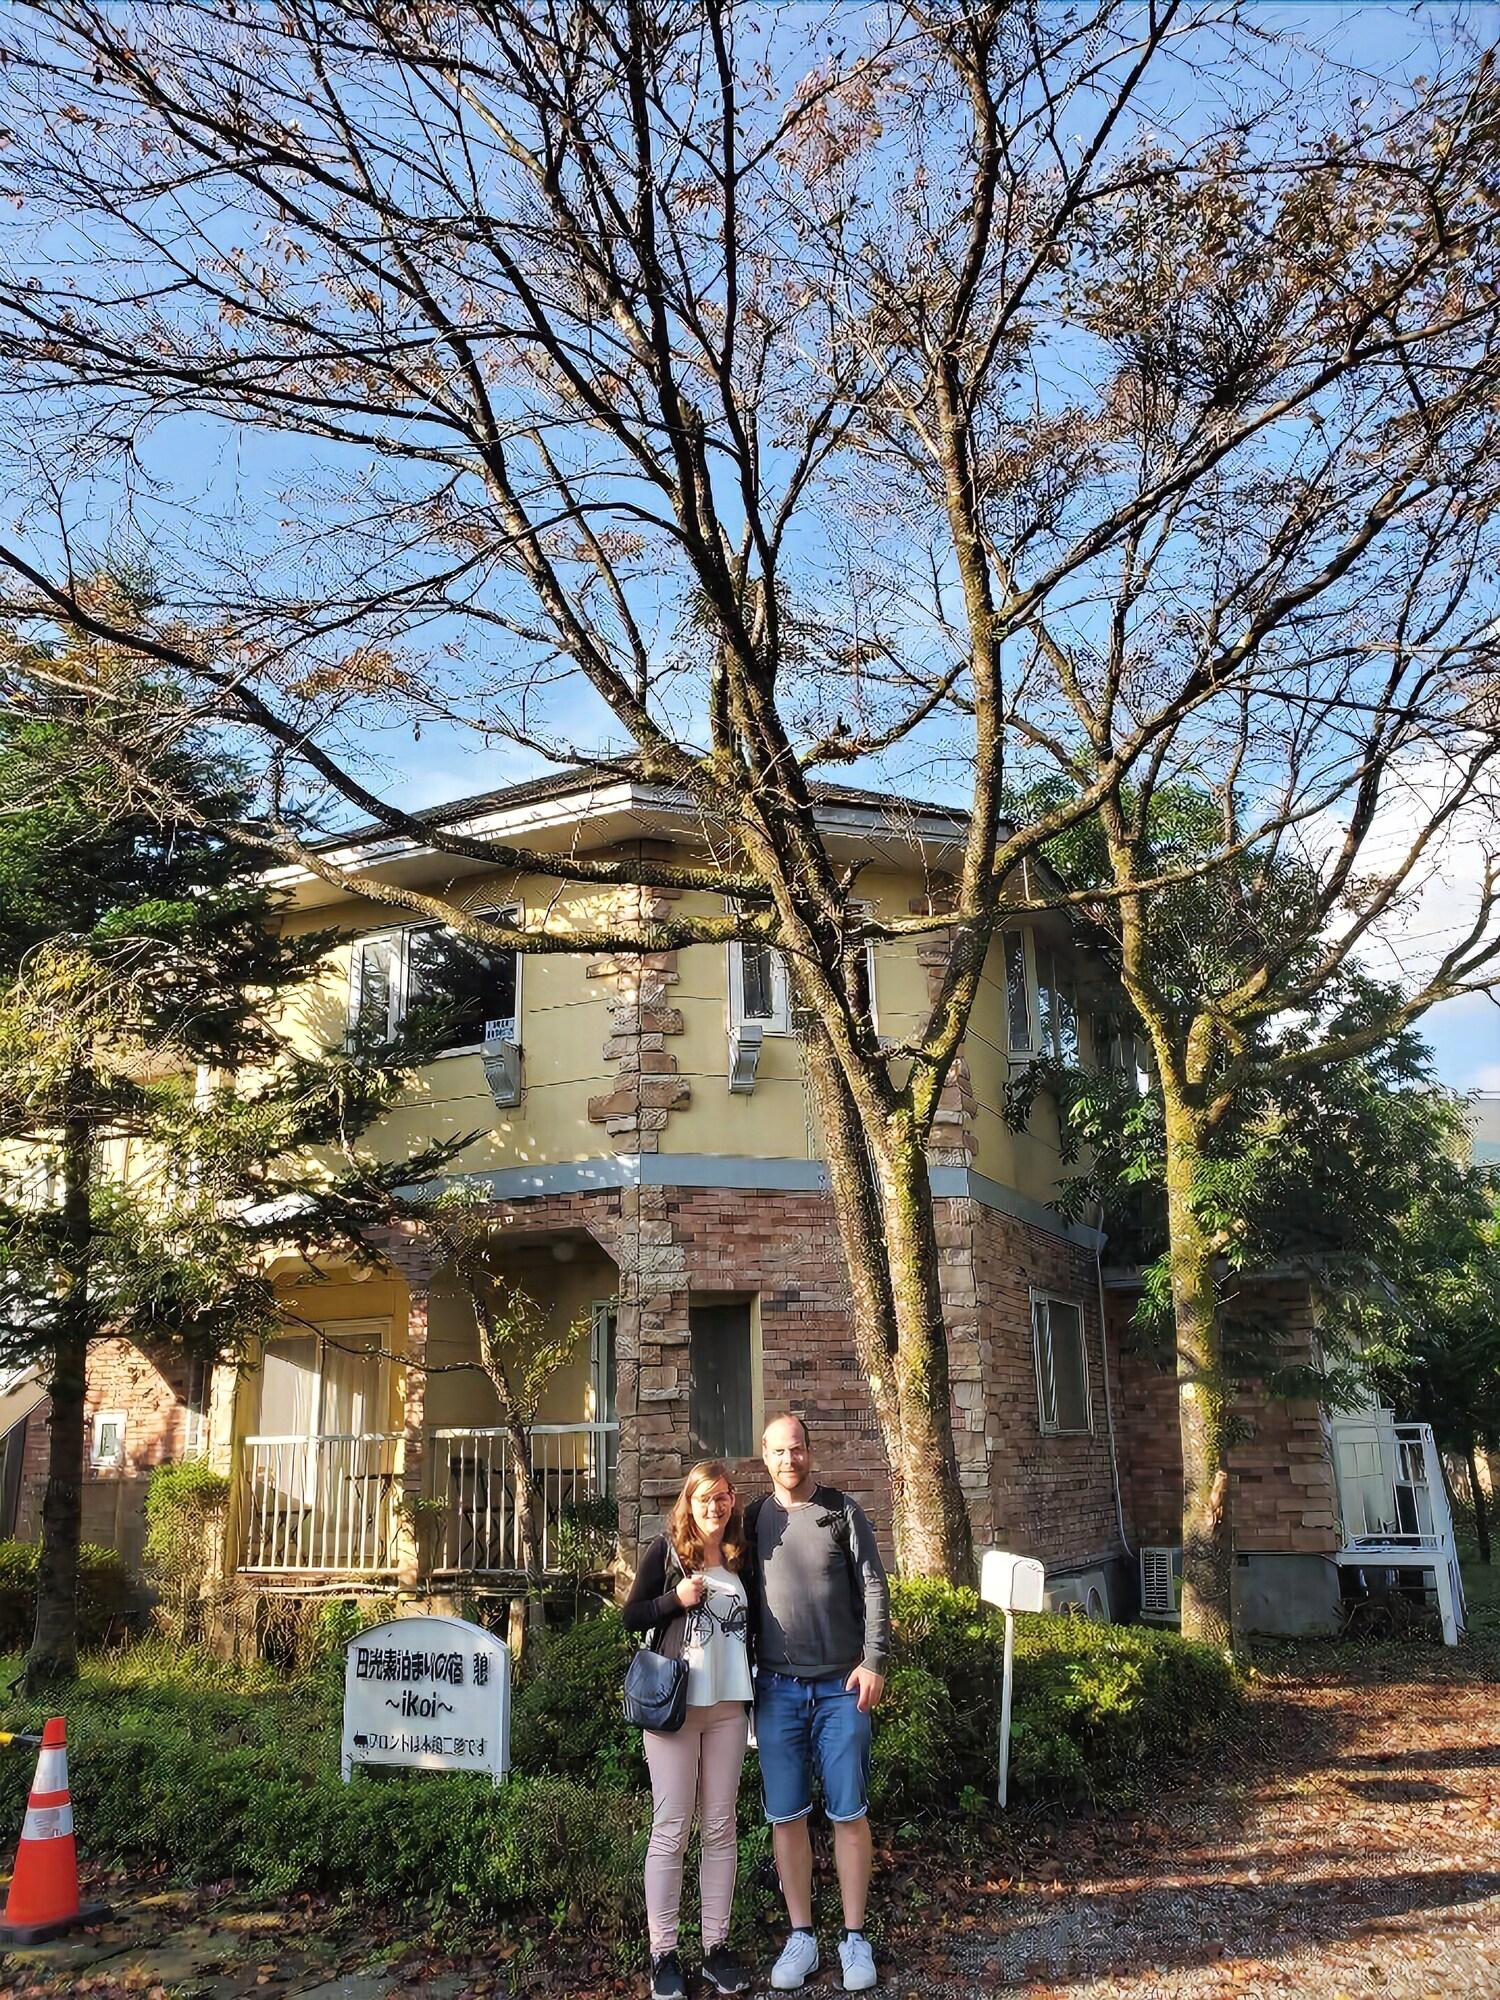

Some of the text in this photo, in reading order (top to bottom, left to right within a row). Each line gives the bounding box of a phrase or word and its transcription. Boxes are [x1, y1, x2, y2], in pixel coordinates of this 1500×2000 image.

[356, 1647, 464, 1685] 日光素泊まりの宿
